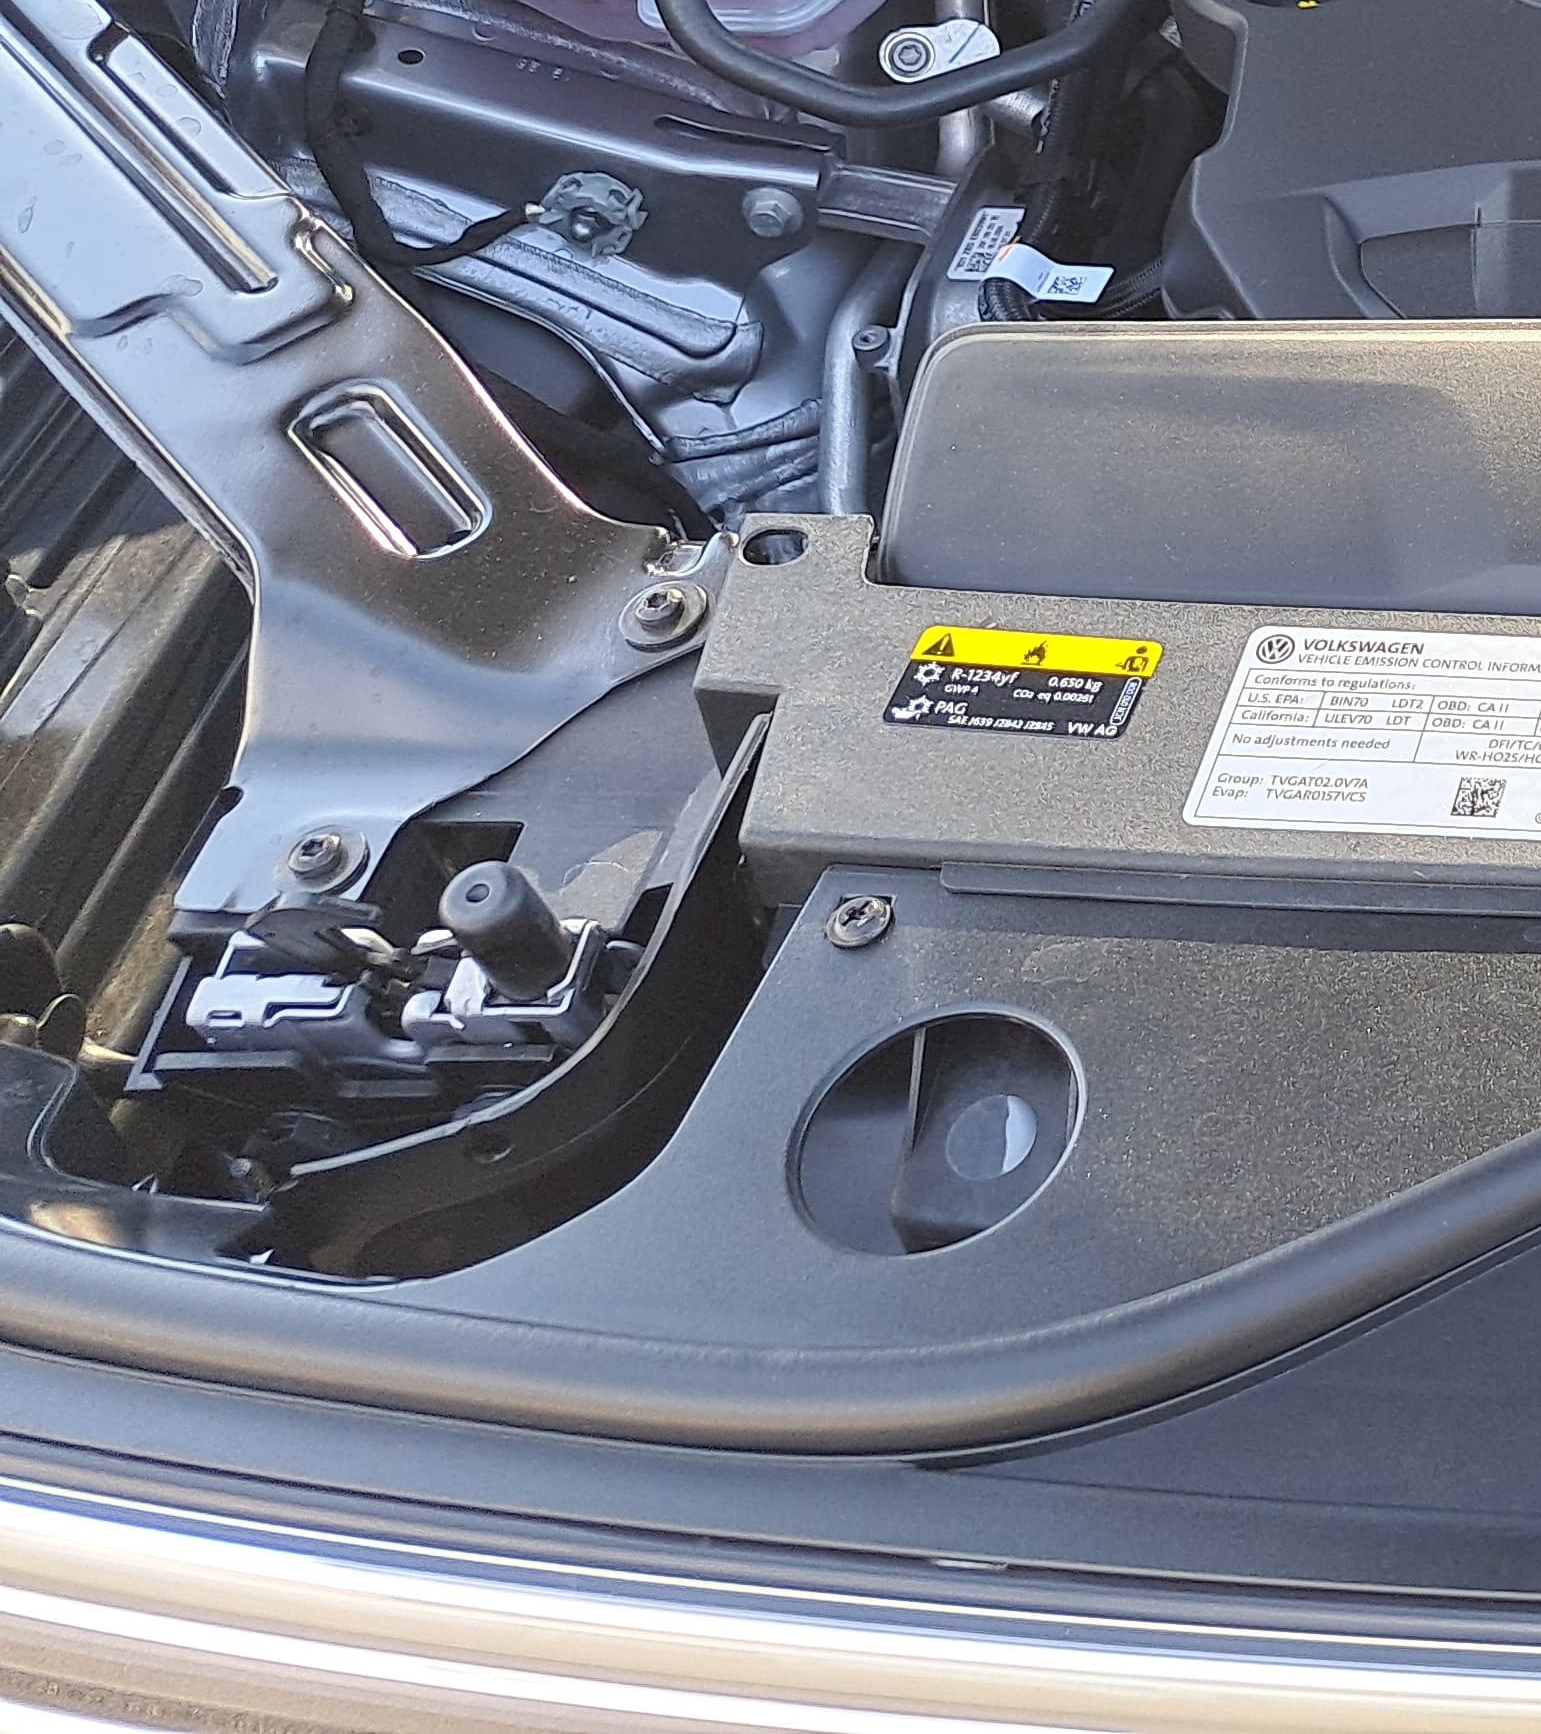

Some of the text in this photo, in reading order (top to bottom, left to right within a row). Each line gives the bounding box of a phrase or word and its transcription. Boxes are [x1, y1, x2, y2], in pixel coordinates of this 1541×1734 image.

[1304, 638, 1425, 655] VOLKSWAGEN
[1298, 654, 1351, 666] VEHICLE
[1355, 656, 1418, 668] EMISSION
[1423, 658, 1483, 671] CONTROL
[951, 670, 1103, 692] R-1234yf 0.650 kg
[1254, 674, 1416, 691] Conforms to regulations:
[1037, 693, 1051, 702] eq
[1248, 693, 1271, 705] U.S.
[1330, 696, 1424, 710] BIN70 LDT2
[934, 702, 968, 714] PAG
[1438, 700, 1471, 711] OBD:
[1477, 702, 1496, 713] CA
[948, 716, 968, 725] SAE
[1241, 709, 1310, 723] California:
[1325, 713, 1411, 726] ULEV70 LDT
[1068, 722, 1118, 736] VW AG
[1432, 718, 1466, 729] OBD:
[1472, 719, 1490, 730] CA
[1232, 733, 1390, 750] No adjustments needed
[1217, 773, 1263, 786] Group:
[1212, 785, 1248, 798] Evap:
